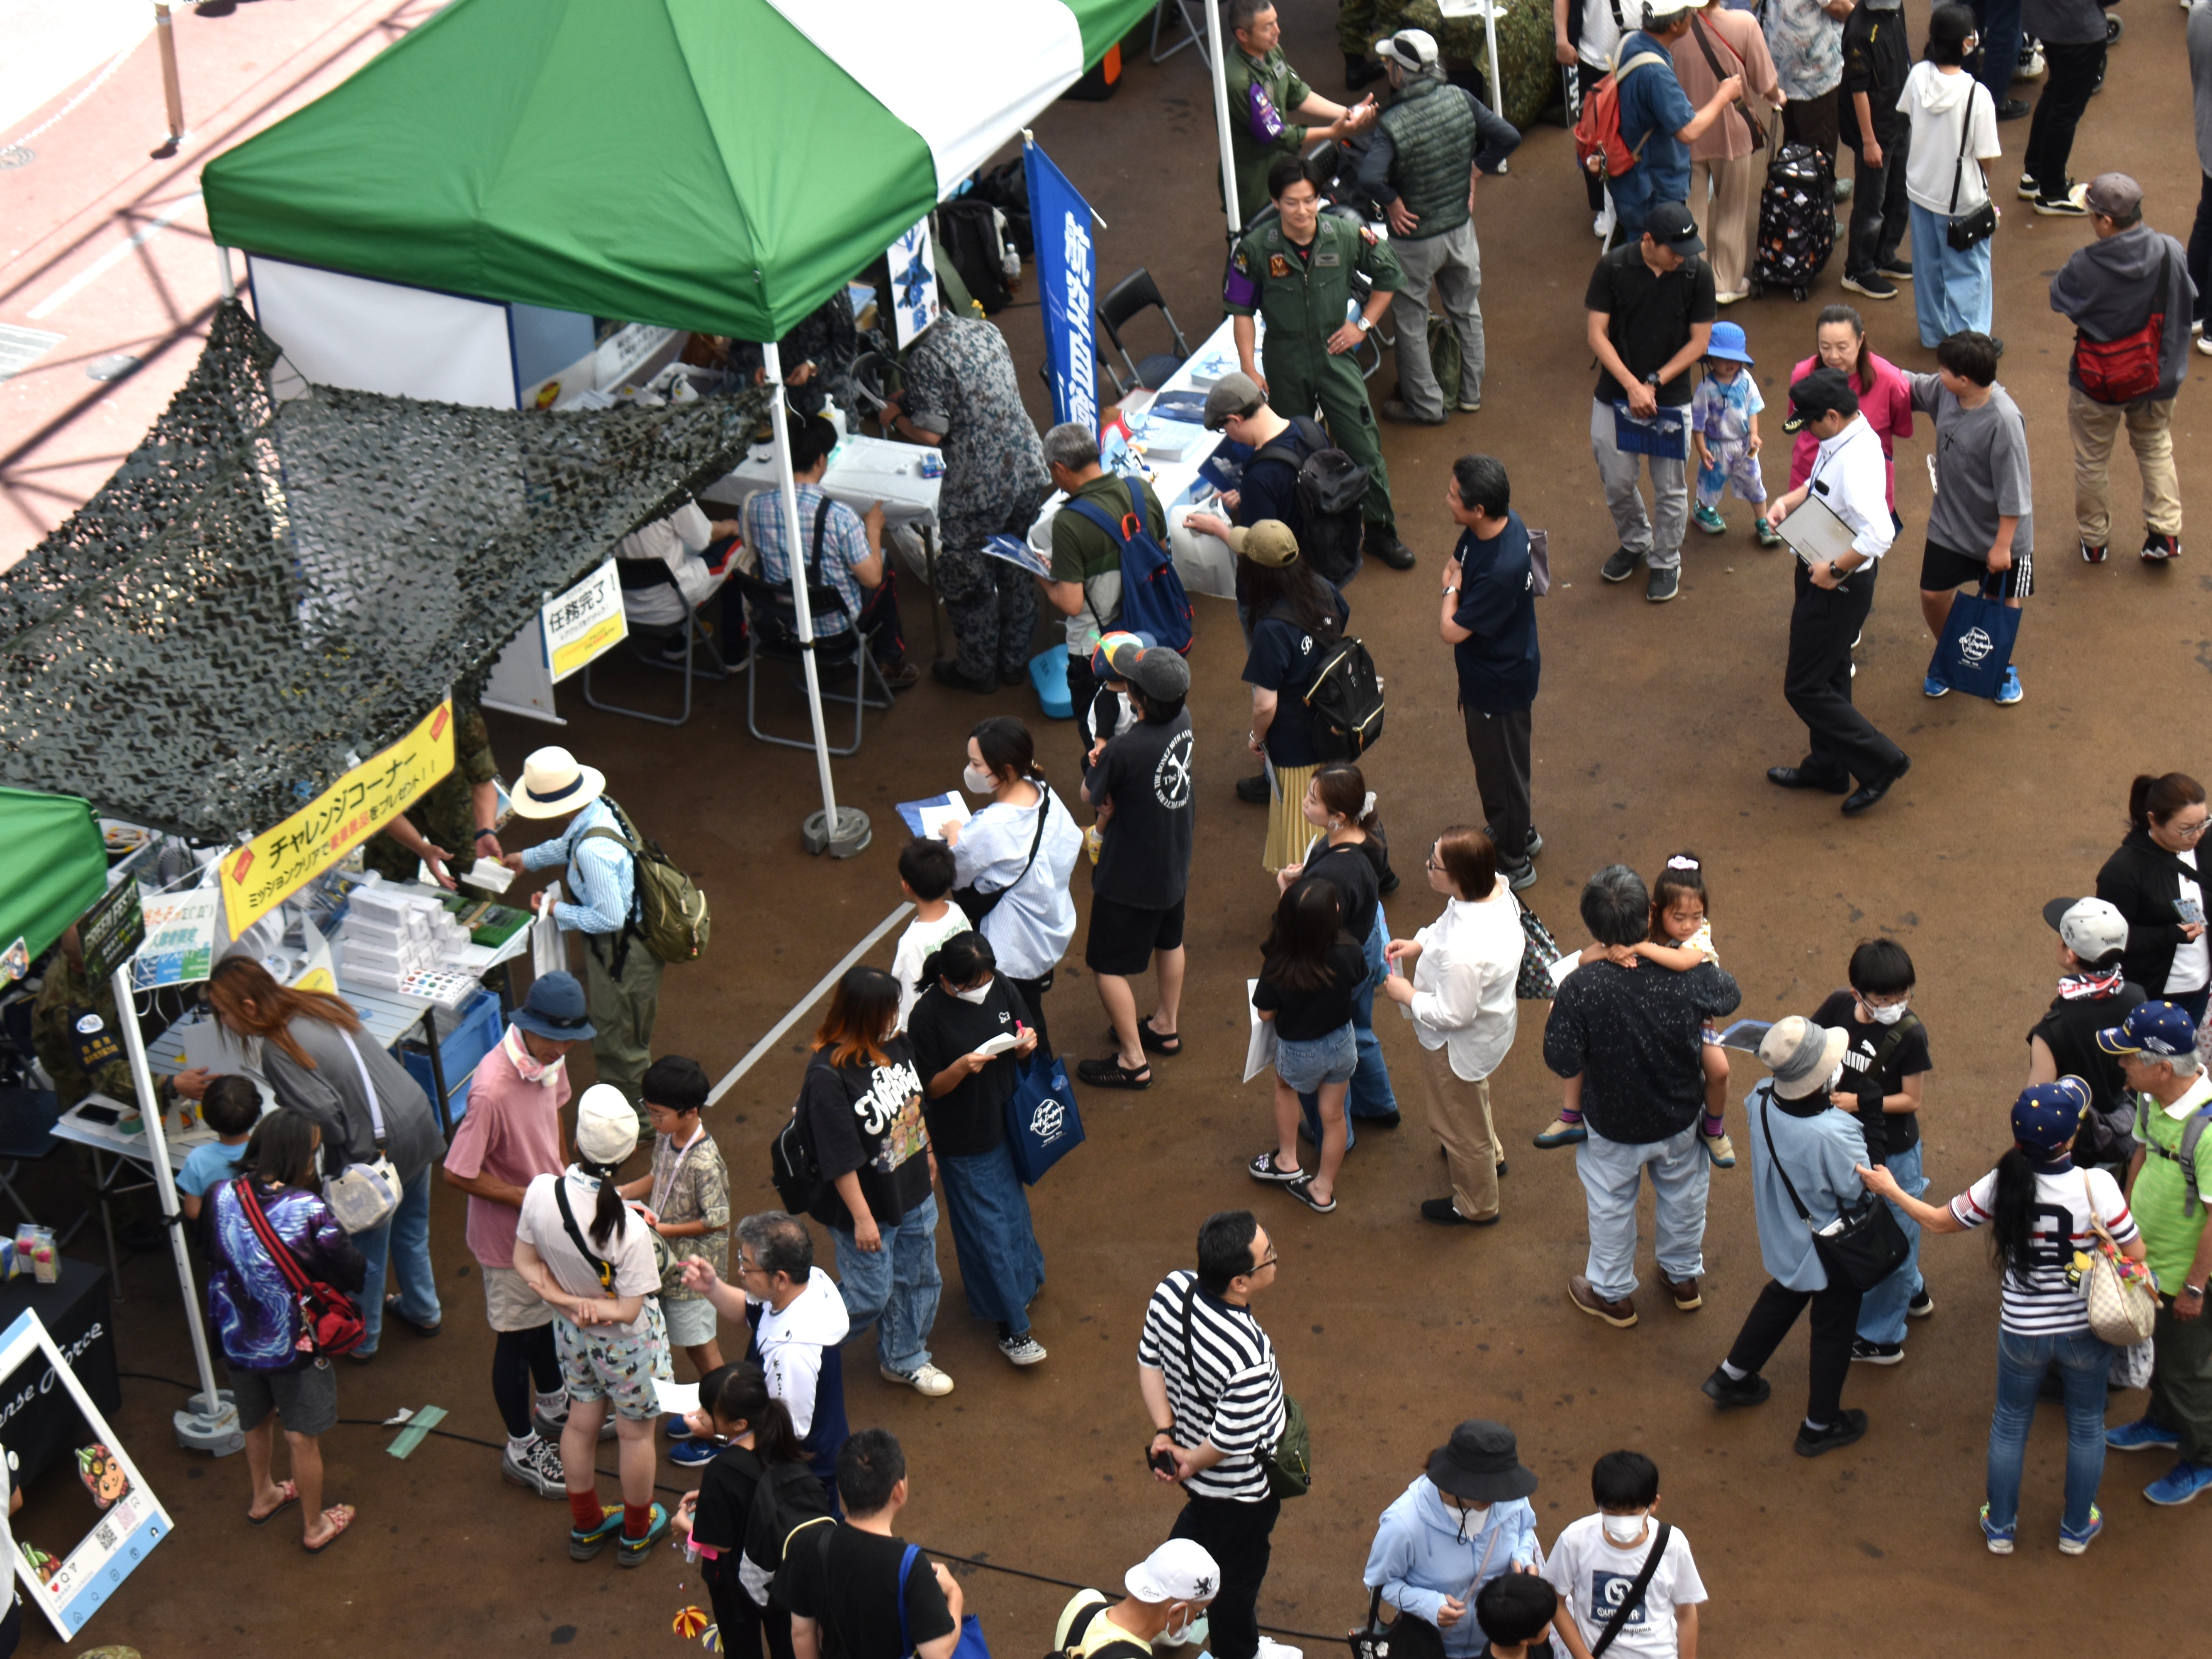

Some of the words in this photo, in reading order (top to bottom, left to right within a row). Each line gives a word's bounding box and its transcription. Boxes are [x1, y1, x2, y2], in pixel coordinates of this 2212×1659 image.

[270, 752, 417, 869] チャレンジコーナー
[1842, 1049, 1872, 1073] UM
[1597, 1606, 1638, 1620] OUTR
